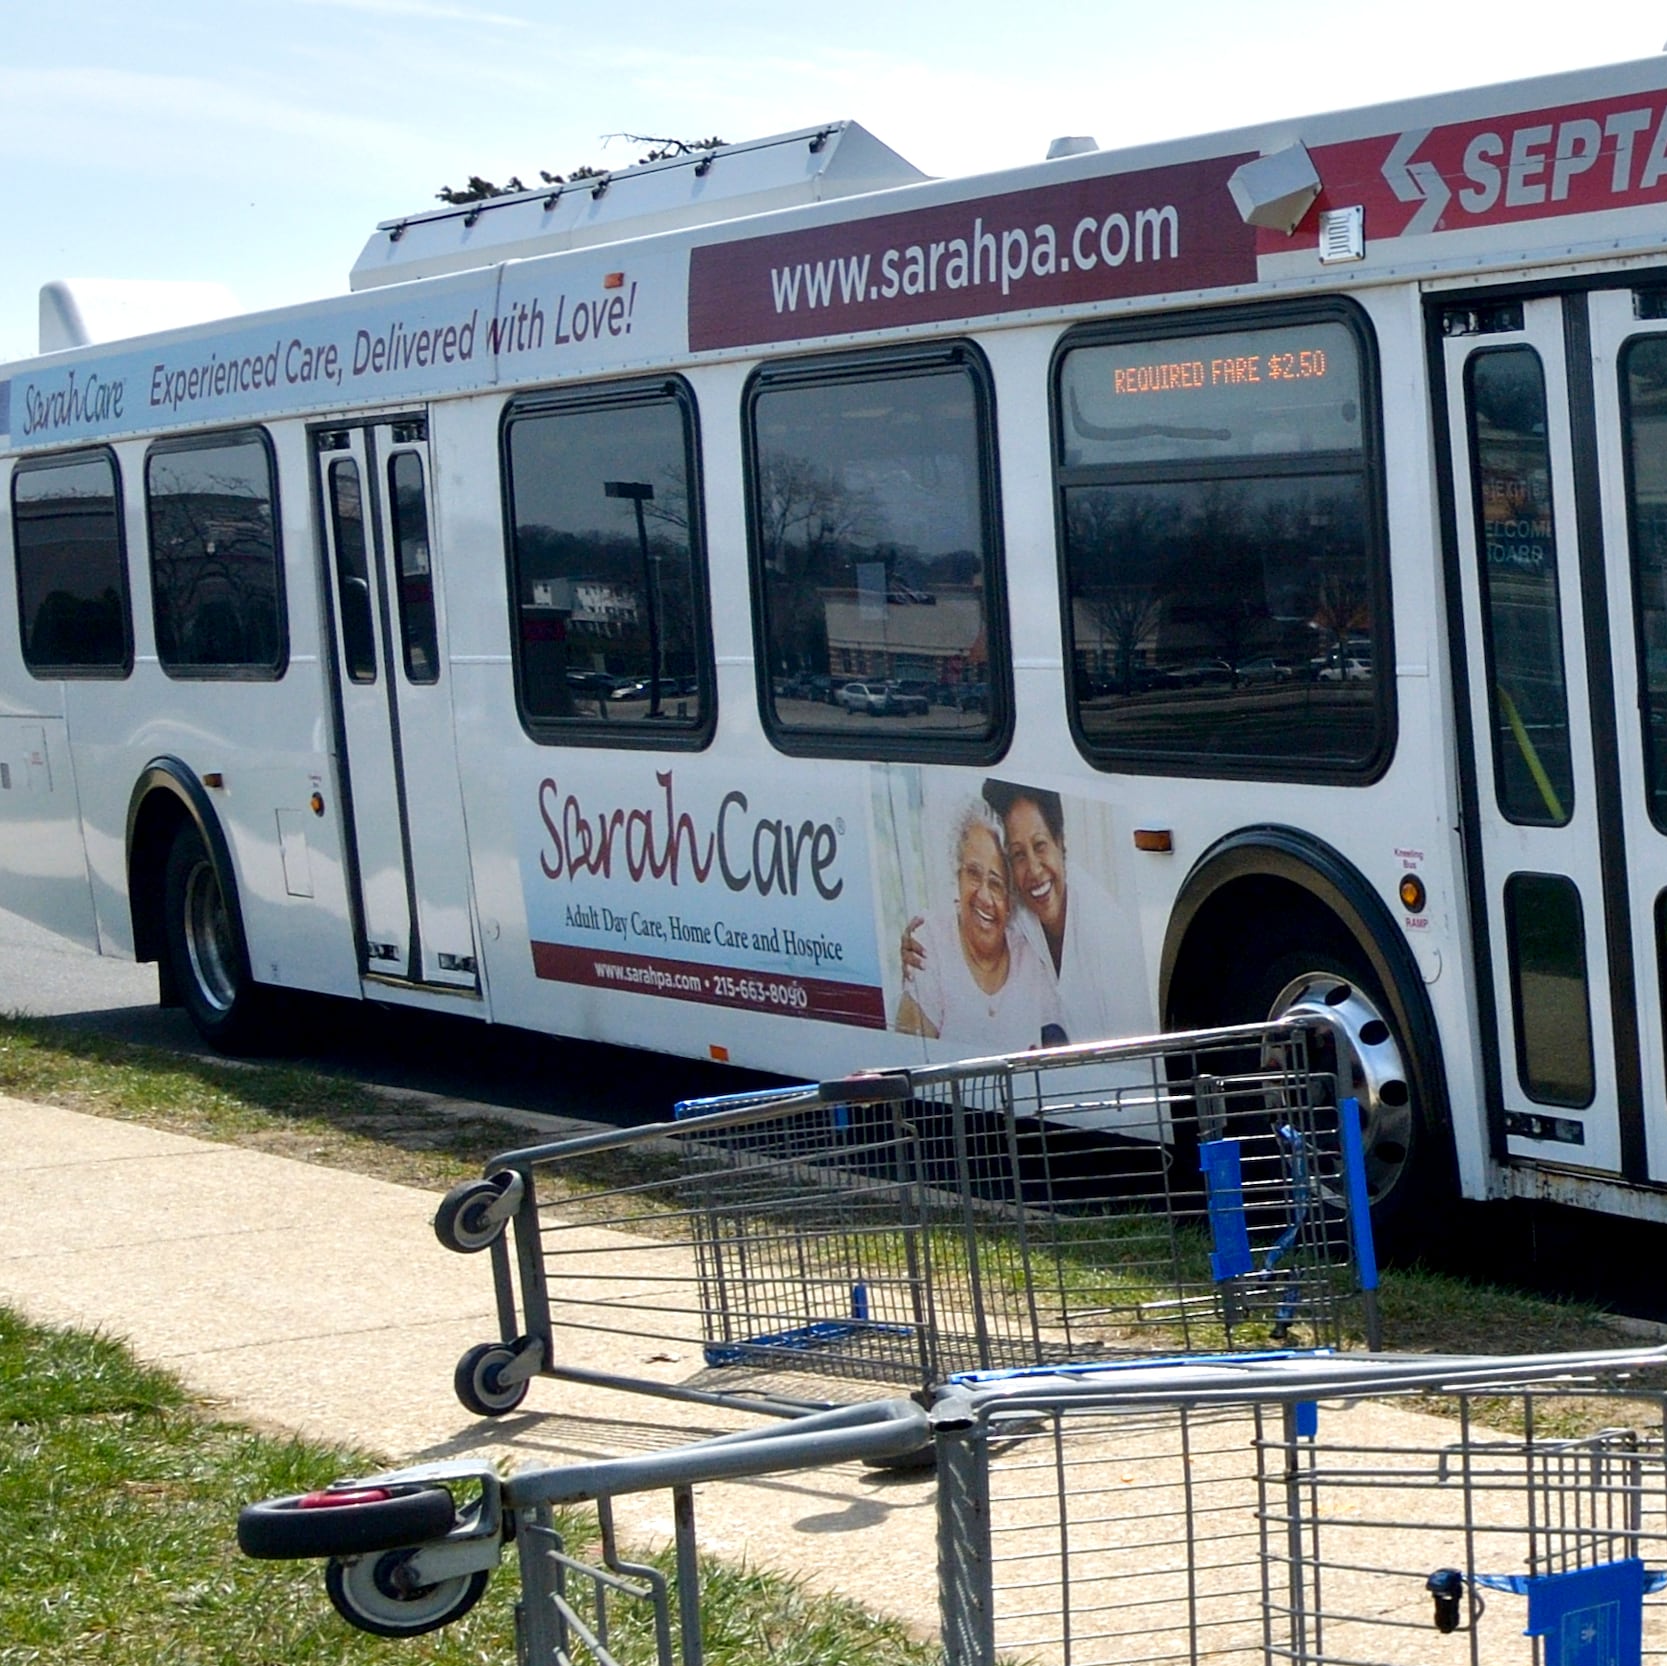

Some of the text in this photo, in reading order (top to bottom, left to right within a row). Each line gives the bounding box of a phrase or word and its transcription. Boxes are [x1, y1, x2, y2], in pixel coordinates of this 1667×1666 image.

[769, 203, 1180, 314] www.sarahpa.com
[149, 339, 280, 412] Experienced
[285, 338, 342, 387] Care,
[352, 308, 478, 377] Delivered
[485, 298, 544, 356] with
[554, 281, 638, 346] Love!
[1114, 349, 1327, 394] REQUIRED FARE $2.50
[538, 769, 844, 901] SarahCare
[1403, 860, 1417, 869] Bus
[565, 903, 844, 966] Adult Day Care, Home Care and Hospice
[1405, 917, 1429, 928] RAMP
[594, 961, 808, 1009] www.sarahpa.com 215-663-8090
